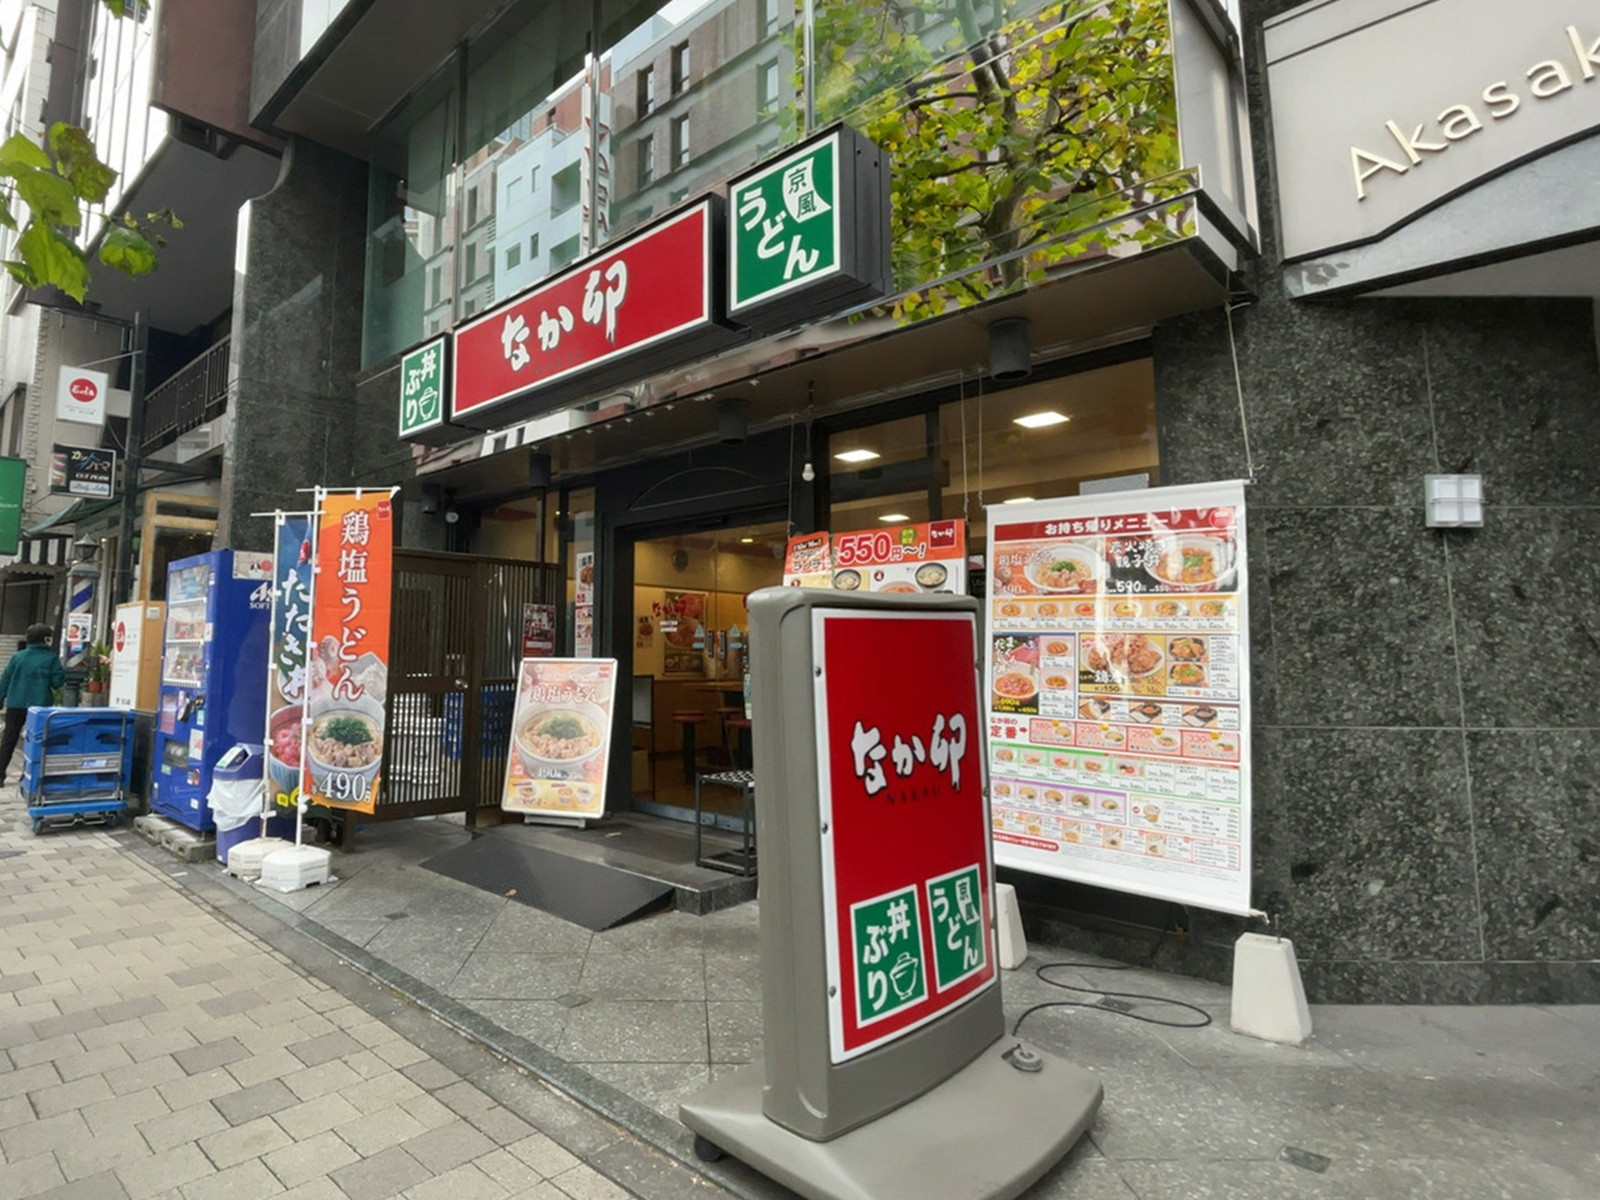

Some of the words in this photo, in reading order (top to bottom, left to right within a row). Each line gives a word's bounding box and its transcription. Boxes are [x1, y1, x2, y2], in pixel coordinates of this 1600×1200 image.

[738, 186, 820, 280] うどん
[787, 166, 817, 219] 京風
[500, 259, 628, 372] なか卯
[405, 348, 437, 427] 丼ぶり
[333, 509, 370, 701] 鶏塩うどん
[850, 712, 967, 795] なか卯
[862, 898, 912, 1012] 丼ぶり
[932, 887, 979, 971] うどん
